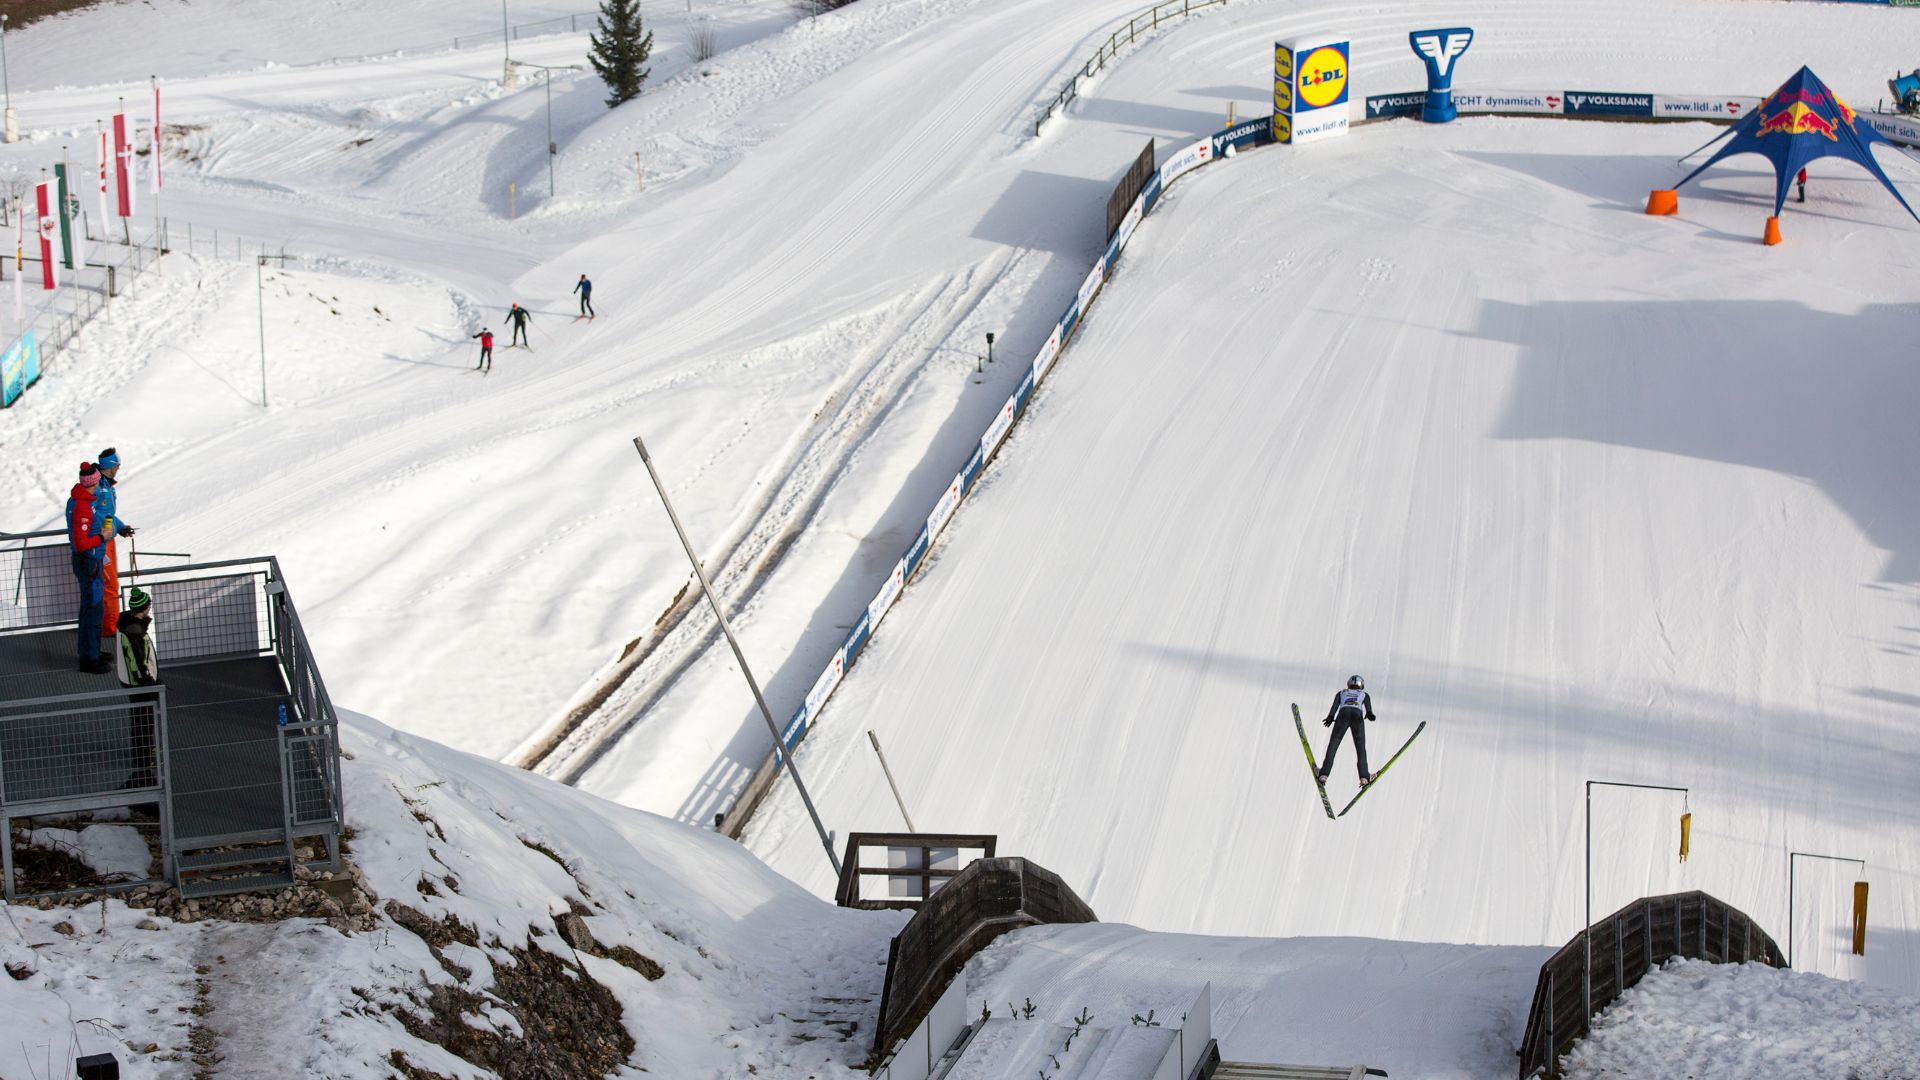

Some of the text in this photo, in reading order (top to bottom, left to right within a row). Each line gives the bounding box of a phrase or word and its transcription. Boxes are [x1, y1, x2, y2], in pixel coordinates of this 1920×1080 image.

[1454, 96, 1544, 108] ECHT dynamisch.
[1588, 96, 1649, 107] VOLKSBANK
[1664, 101, 1723, 113] www.lidl.at
[1225, 121, 1267, 141] VOLKSBANK
[1296, 118, 1347, 137] www.lidl.at
